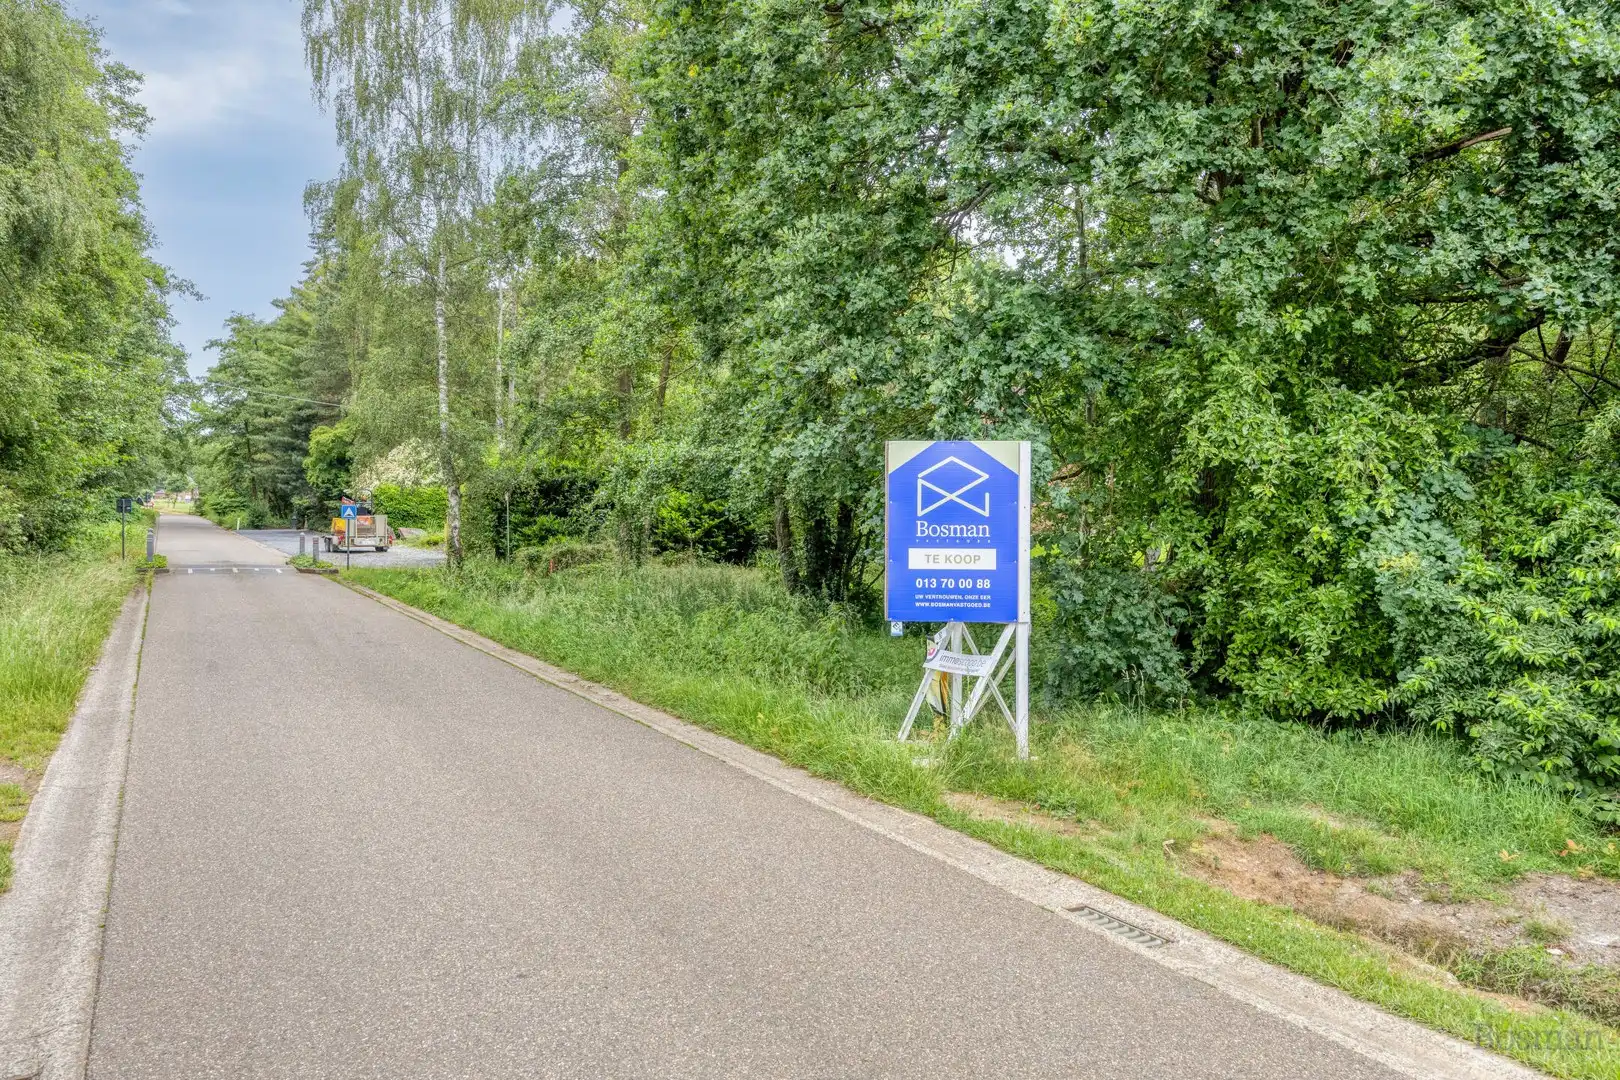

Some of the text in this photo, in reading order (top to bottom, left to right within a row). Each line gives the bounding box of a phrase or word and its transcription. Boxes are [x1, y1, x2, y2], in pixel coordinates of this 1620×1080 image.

[915, 520, 990, 538] Bosman
[924, 554, 982, 564] TE KOOP
[915, 578, 991, 589] 013 70 00 88
